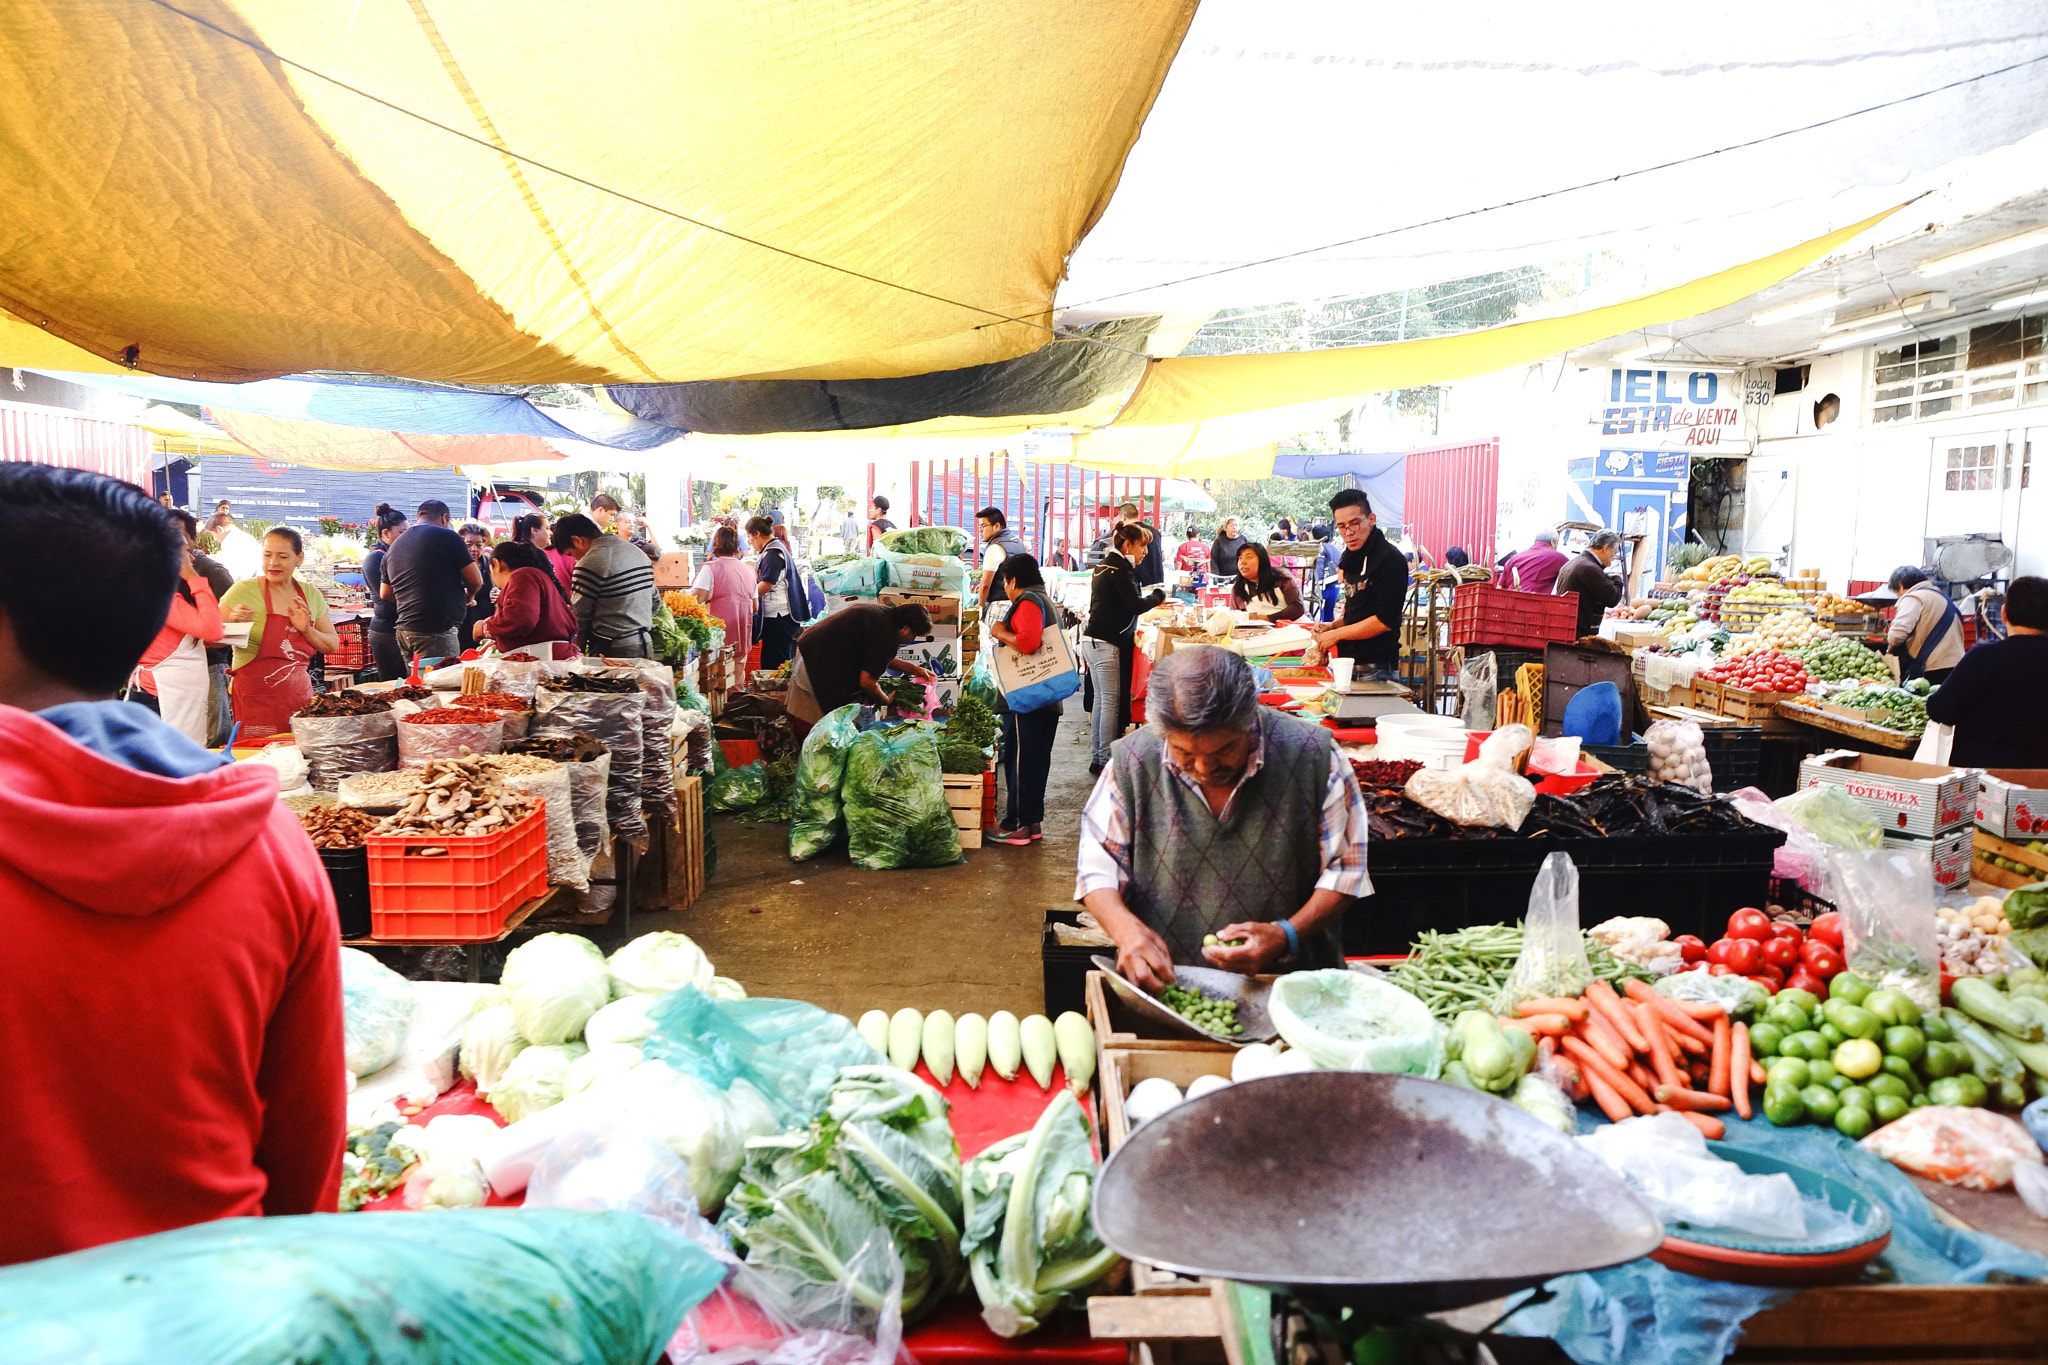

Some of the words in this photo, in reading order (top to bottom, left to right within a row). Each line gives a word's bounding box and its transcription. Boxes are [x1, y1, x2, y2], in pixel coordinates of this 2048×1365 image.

[1745, 380, 1771, 390] LOCAL
[1745, 391, 1770, 406] 530
[1673, 408, 1692, 425] de
[1696, 408, 1737, 425] VENTA
[1685, 428, 1721, 446] AQUI
[1657, 454, 1687, 468] FIESTA
[1845, 784, 1920, 806] TOTEMEX
